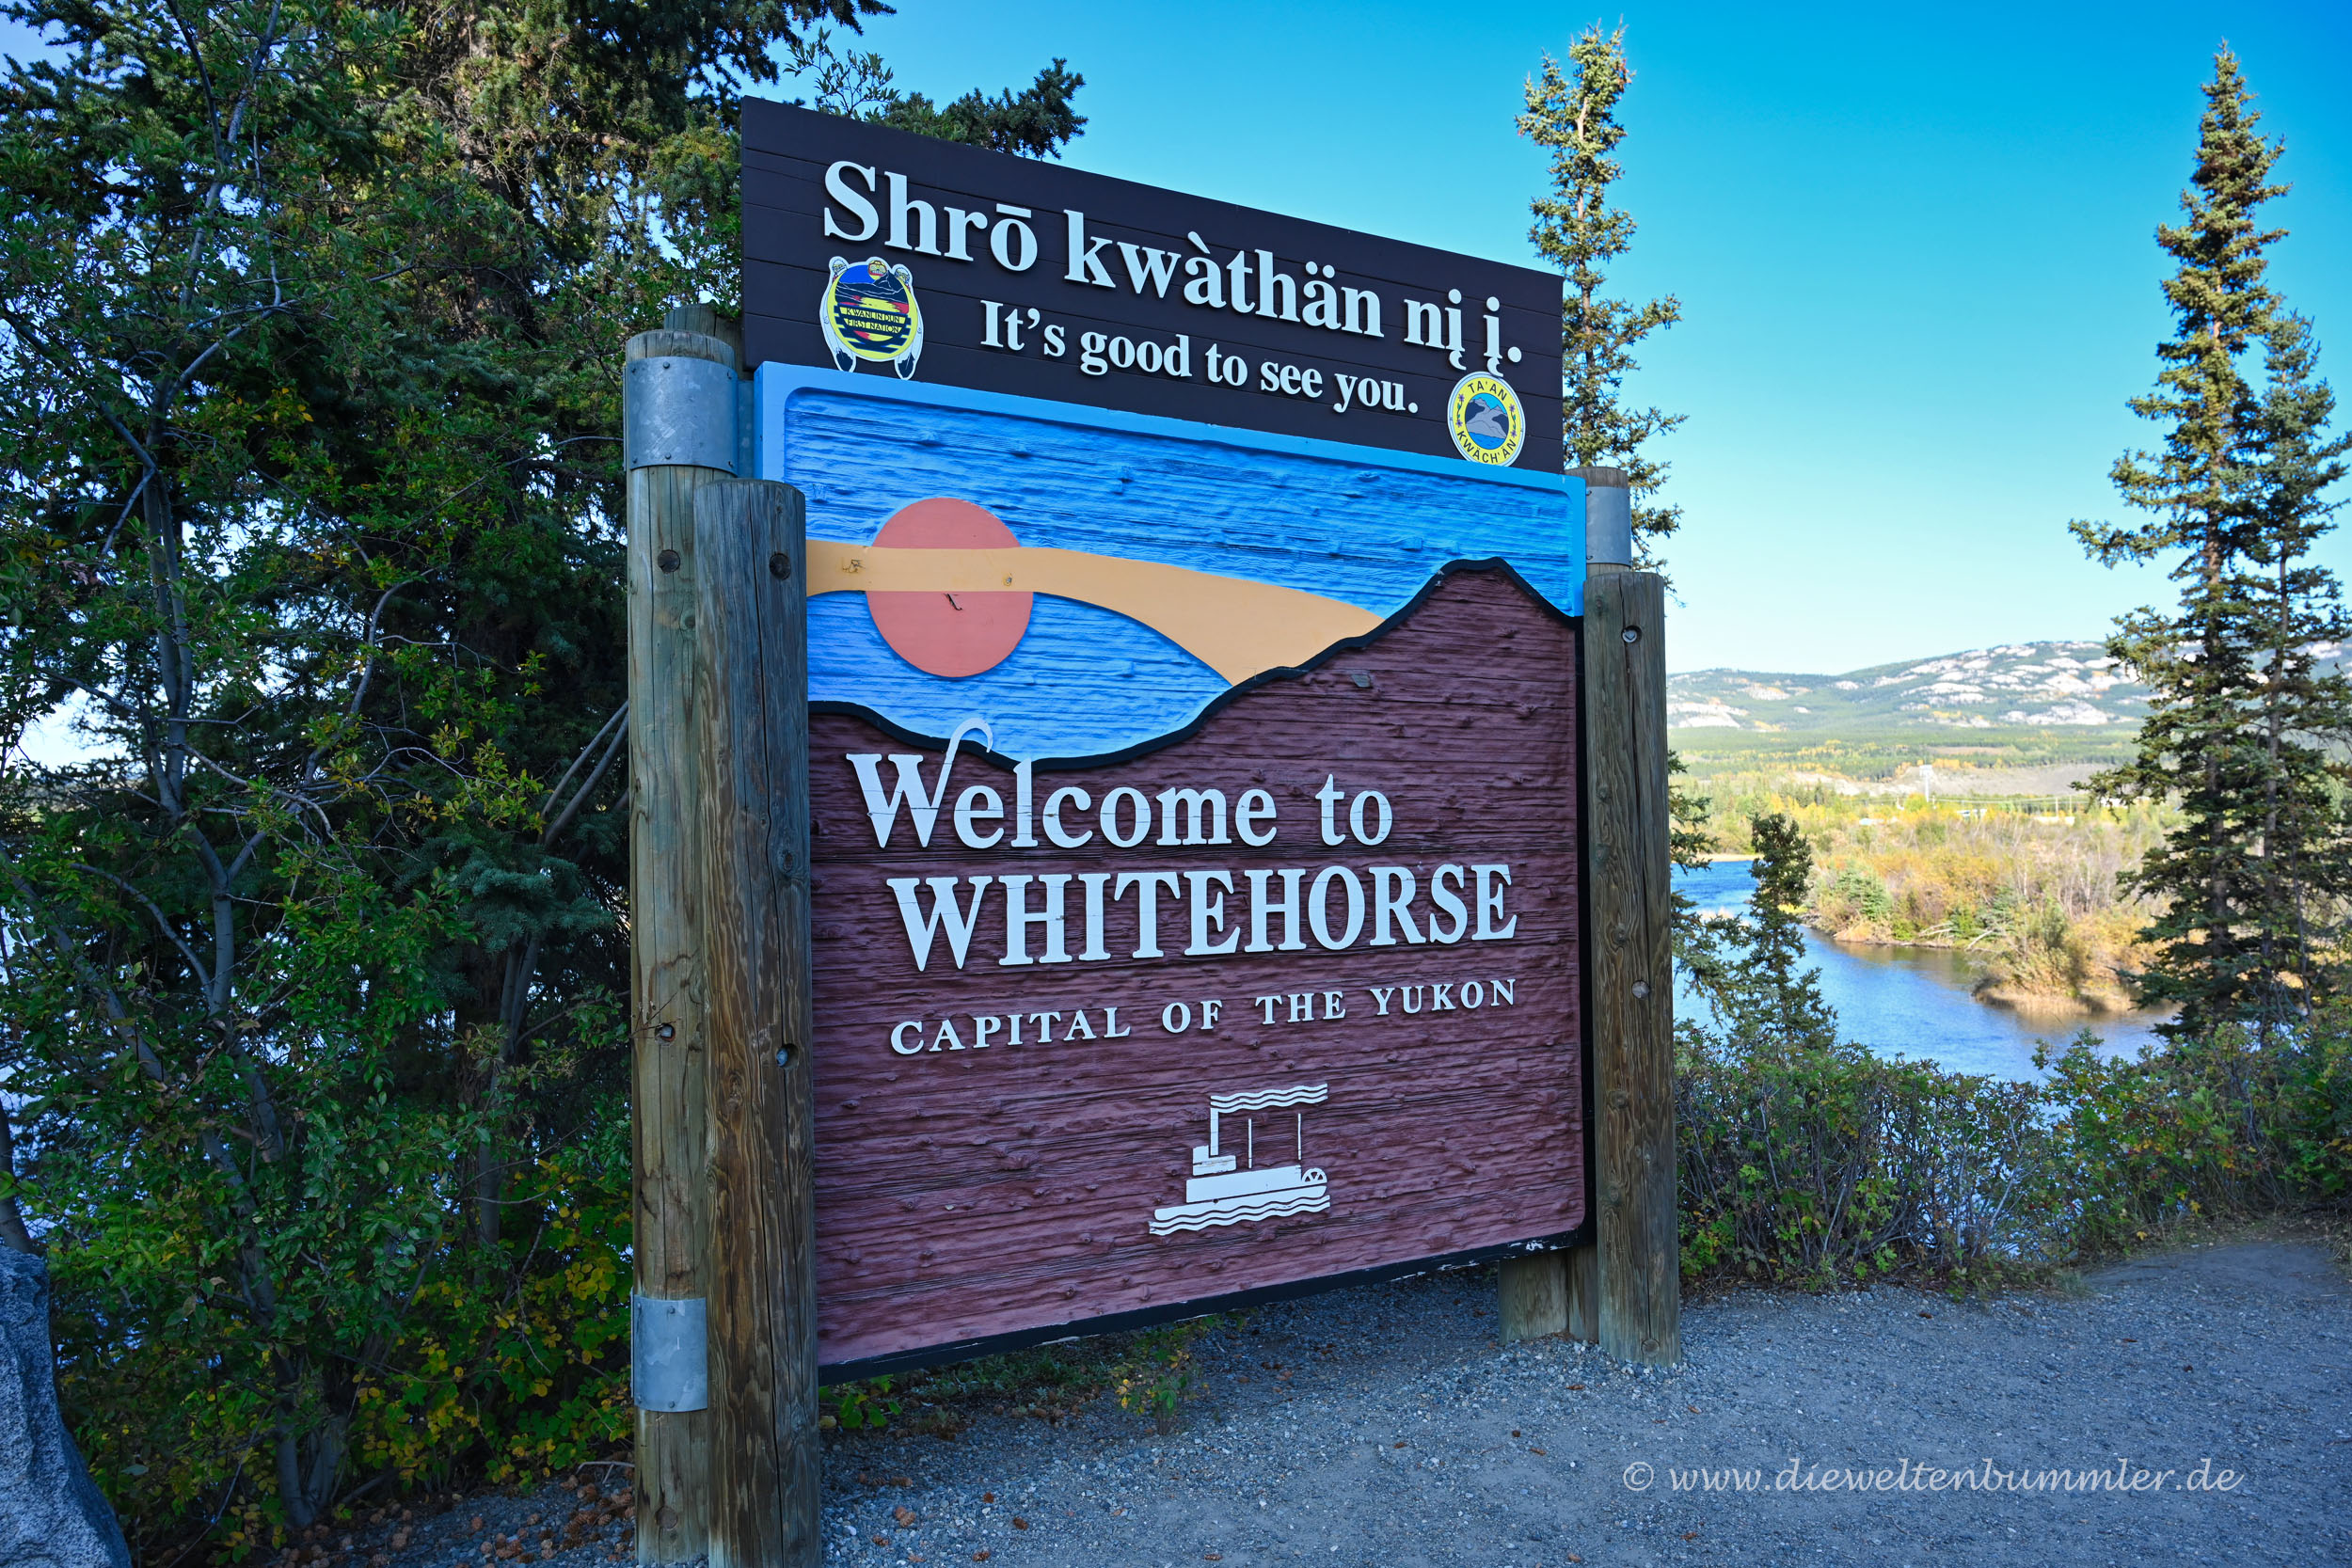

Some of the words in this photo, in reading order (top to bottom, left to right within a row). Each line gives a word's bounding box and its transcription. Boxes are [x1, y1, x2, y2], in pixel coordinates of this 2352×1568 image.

[823, 161, 1038, 273] Shrō
[1063, 210, 1384, 338] kwàthän
[848, 319, 866, 328] FIRST
[869, 323, 899, 333] NATION
[1080, 331, 1192, 377] good
[1205, 342, 1248, 386] to
[1260, 361, 1322, 399] see
[1333, 373, 1419, 414] you.
[846, 717, 1278, 848] Welcome
[1315, 773, 1392, 847] to
[886, 864, 1518, 972] WHITEHORSE
[890, 1007, 1130, 1055] CAPITAL
[1161, 999, 1223, 1034] OF
[1256, 991, 1346, 1026] THE
[1370, 978, 1517, 1016] YUKON
